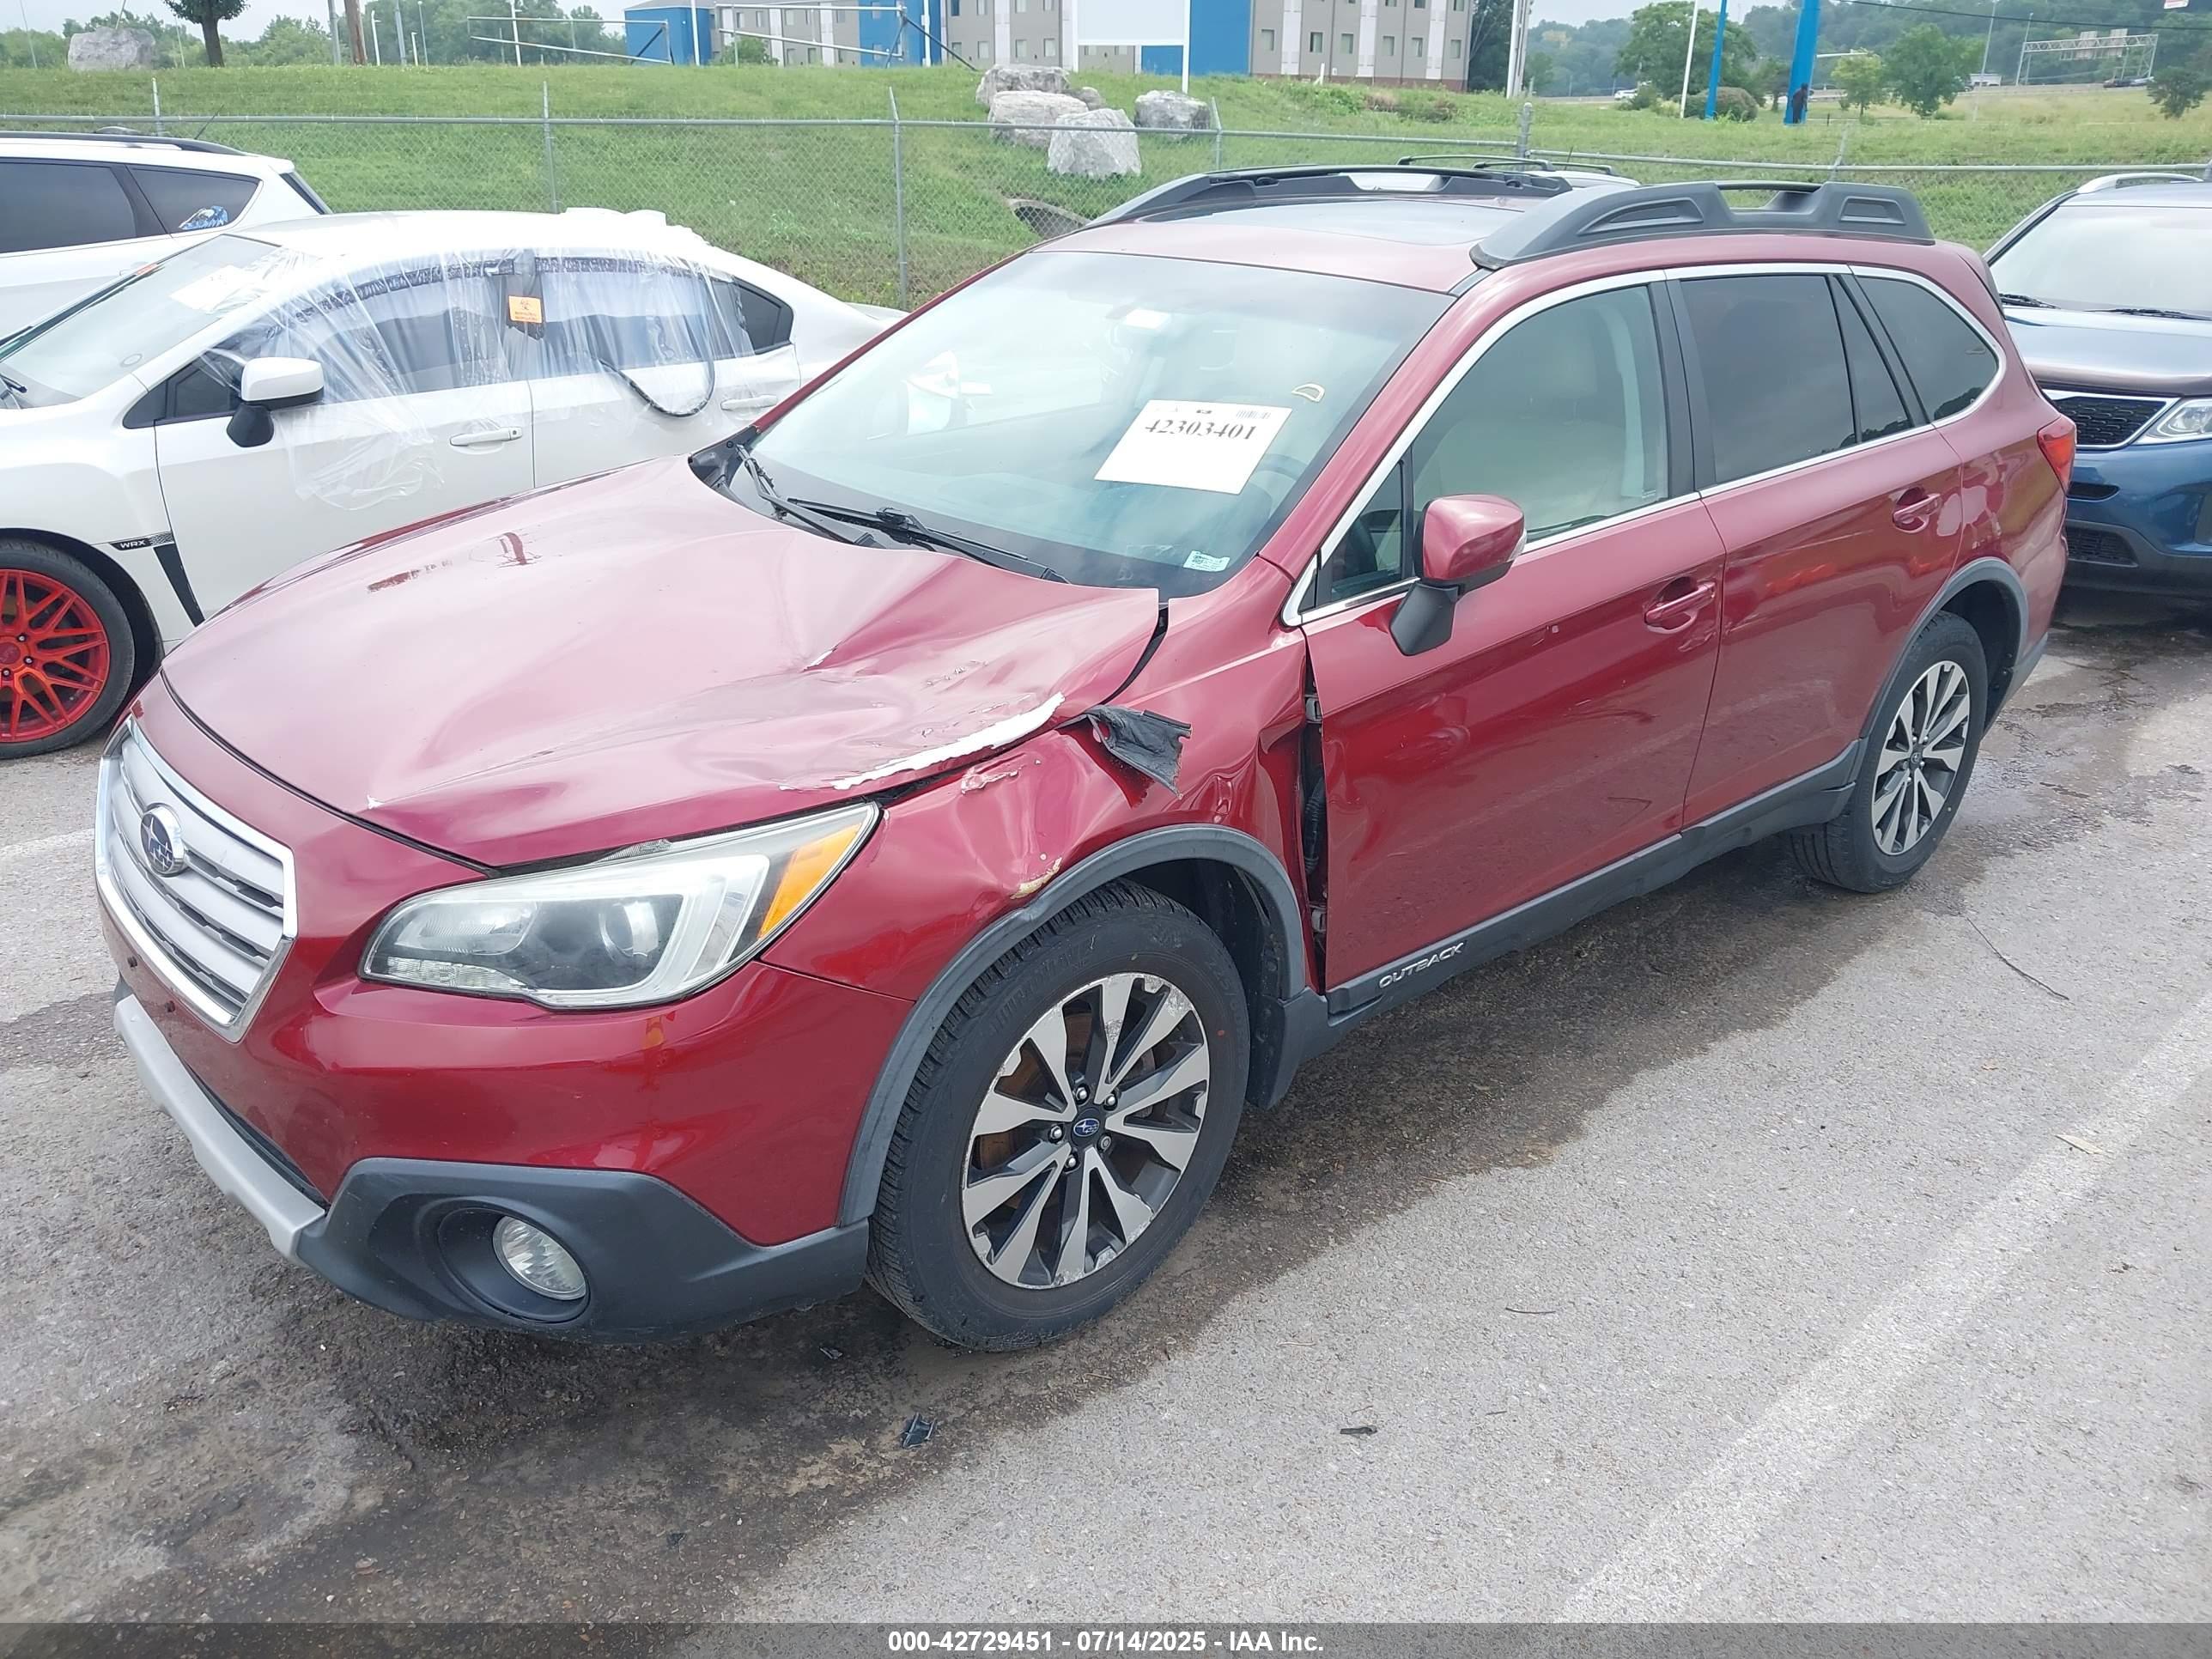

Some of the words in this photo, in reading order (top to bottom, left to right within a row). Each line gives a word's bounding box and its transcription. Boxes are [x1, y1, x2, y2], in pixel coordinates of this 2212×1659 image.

[1145, 419, 1257, 440] 42303401
[121, 540, 146, 549] WRX
[1378, 942, 1464, 988] OUTBACK
